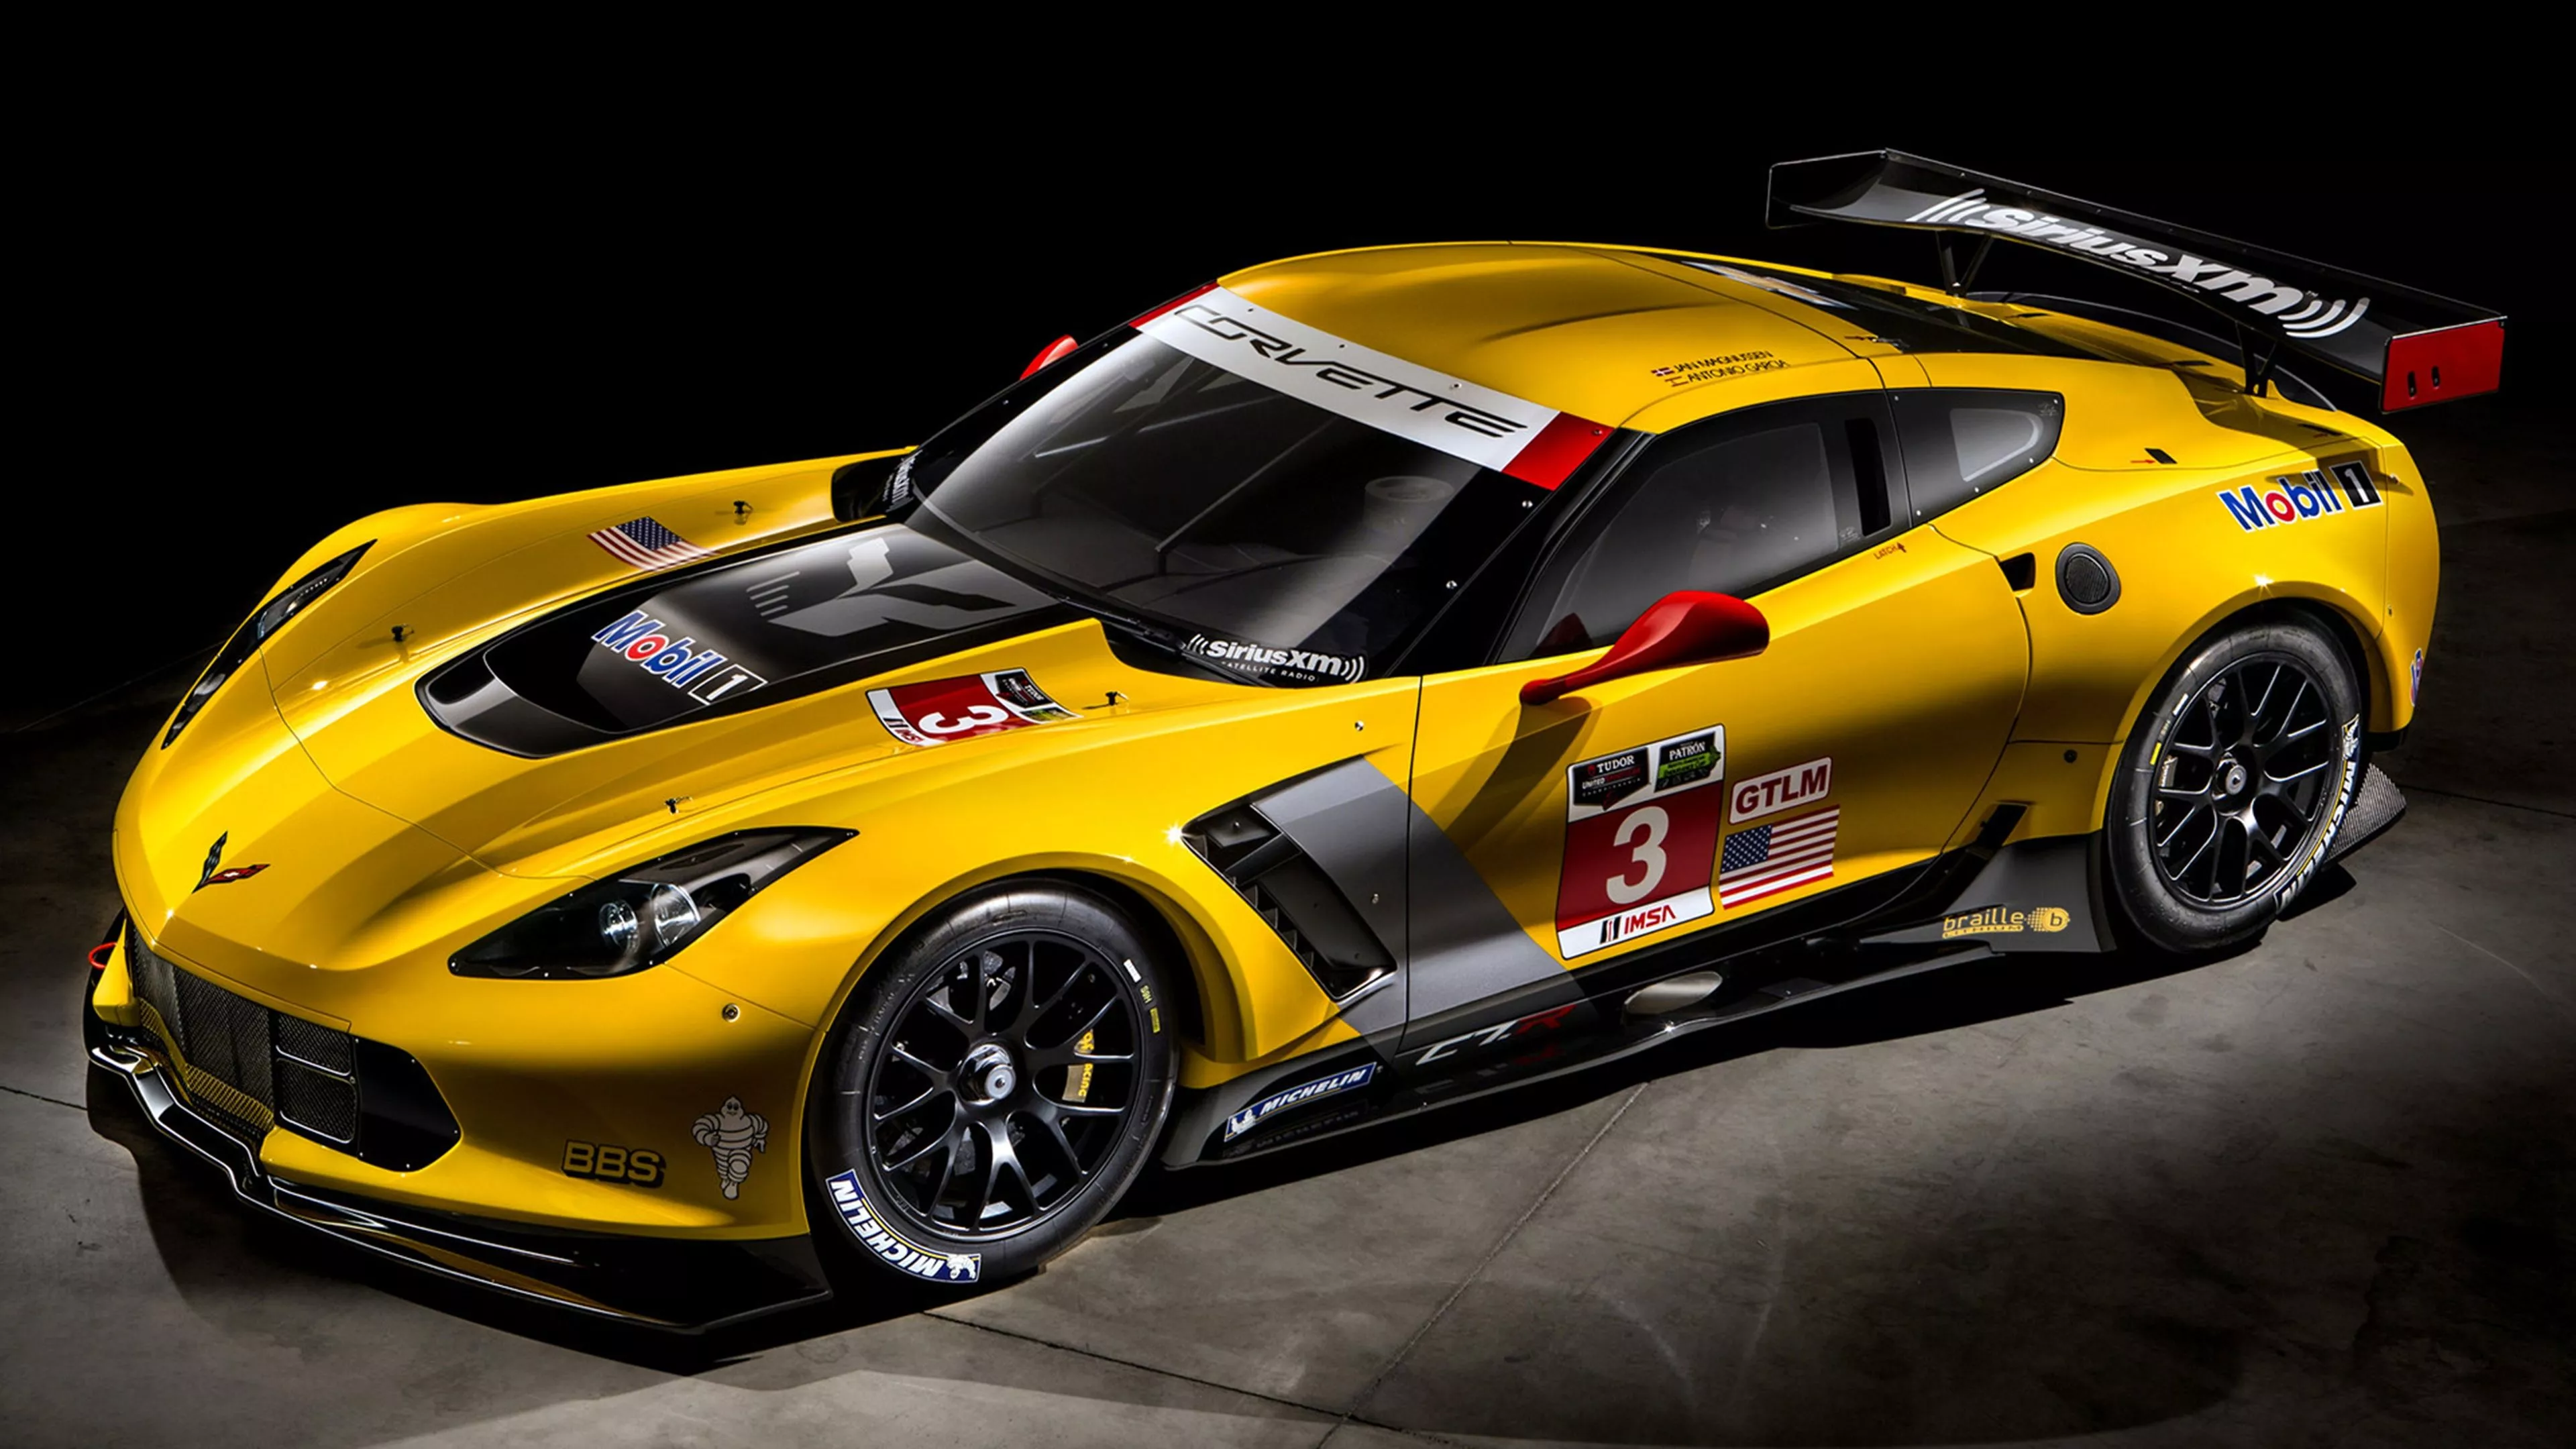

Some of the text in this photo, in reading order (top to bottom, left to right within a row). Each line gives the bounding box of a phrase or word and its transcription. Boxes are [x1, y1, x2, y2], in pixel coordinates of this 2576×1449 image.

[1173, 304, 1528, 439] CORVETTE
[1686, 359, 1791, 382] ANTONIO GARCIA
[2215, 469, 2345, 533] Mobil
[591, 610, 729, 689] Mobil
[1281, 671, 1316, 682] RADIO
[918, 705, 1009, 734] 3
[1597, 754, 1635, 773] TUDOR
[1735, 764, 1829, 815] GTLM
[1605, 806, 1670, 904] 3
[1623, 905, 1676, 934] IMSA
[1942, 907, 2025, 931] braille
[1260, 1067, 1368, 1116] MICHELIN
[561, 1140, 665, 1187] BBS
[829, 1179, 946, 1278] MICHELIN
